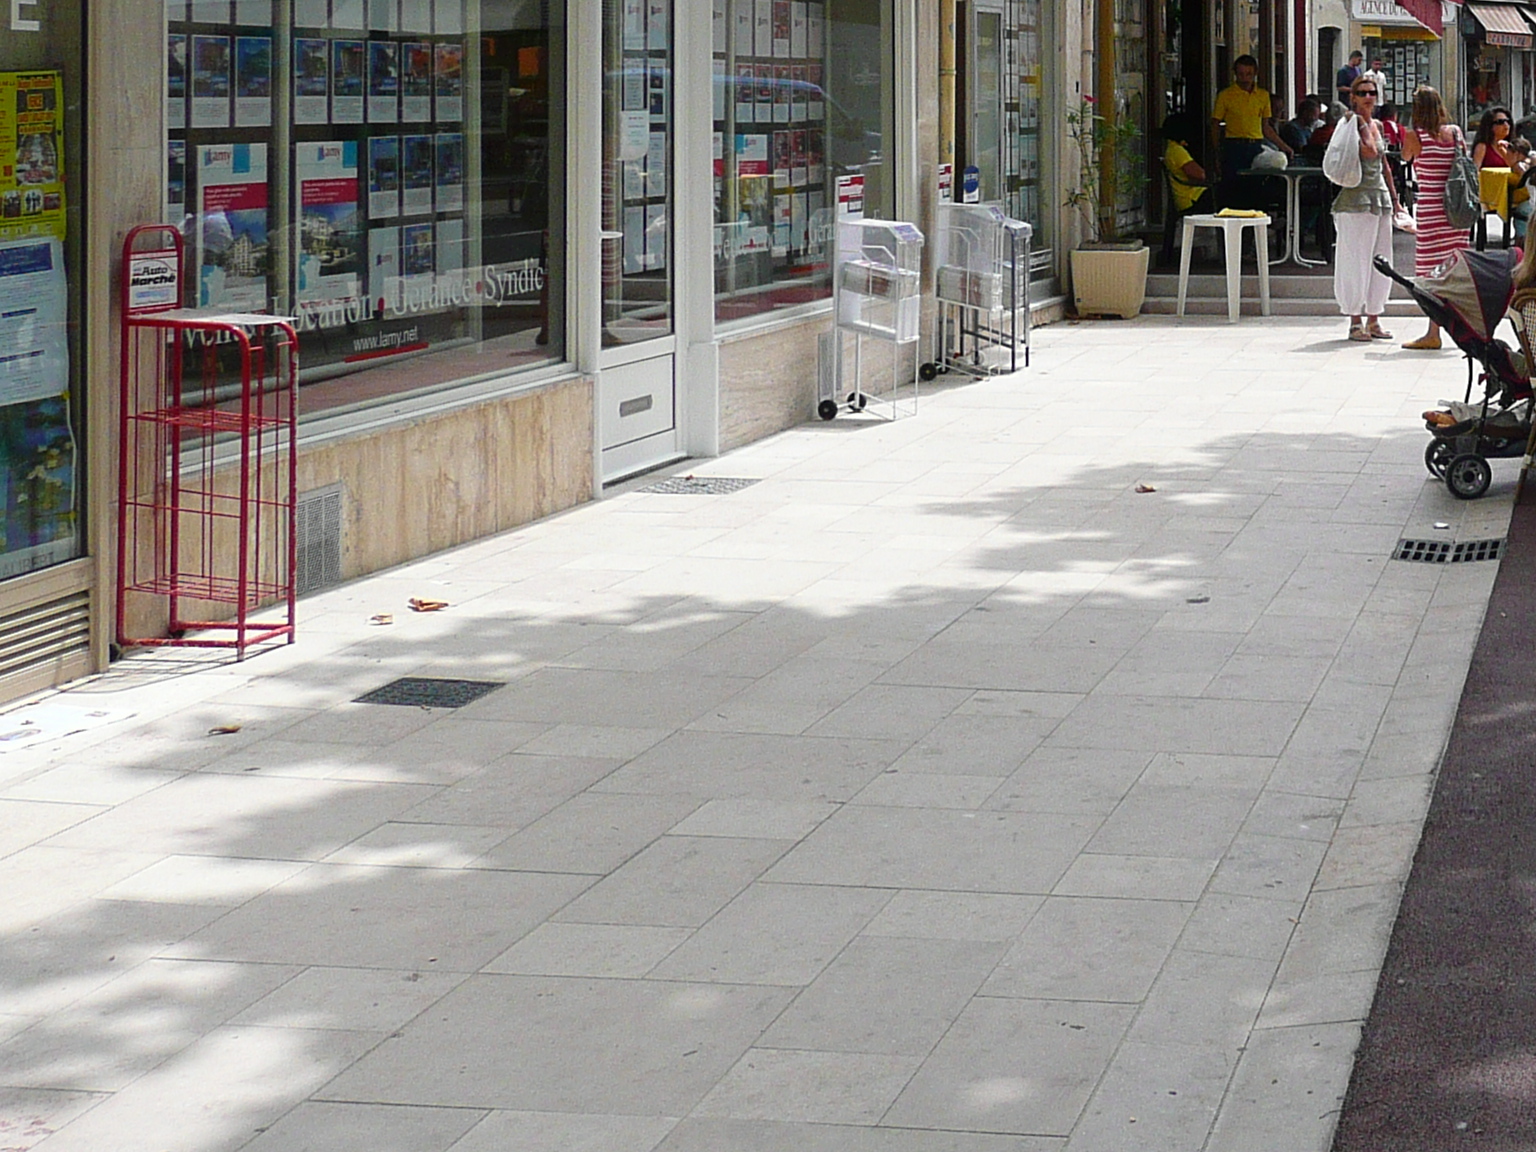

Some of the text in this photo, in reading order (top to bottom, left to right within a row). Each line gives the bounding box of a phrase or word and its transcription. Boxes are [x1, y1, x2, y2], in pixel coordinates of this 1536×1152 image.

[1360, 0, 1388, 15] AGENCE
[142, 266, 168, 277] Auto
[131, 273, 176, 287] Marché
[484, 257, 545, 307] Syndic
[353, 325, 419, 352] www.lamy.net
